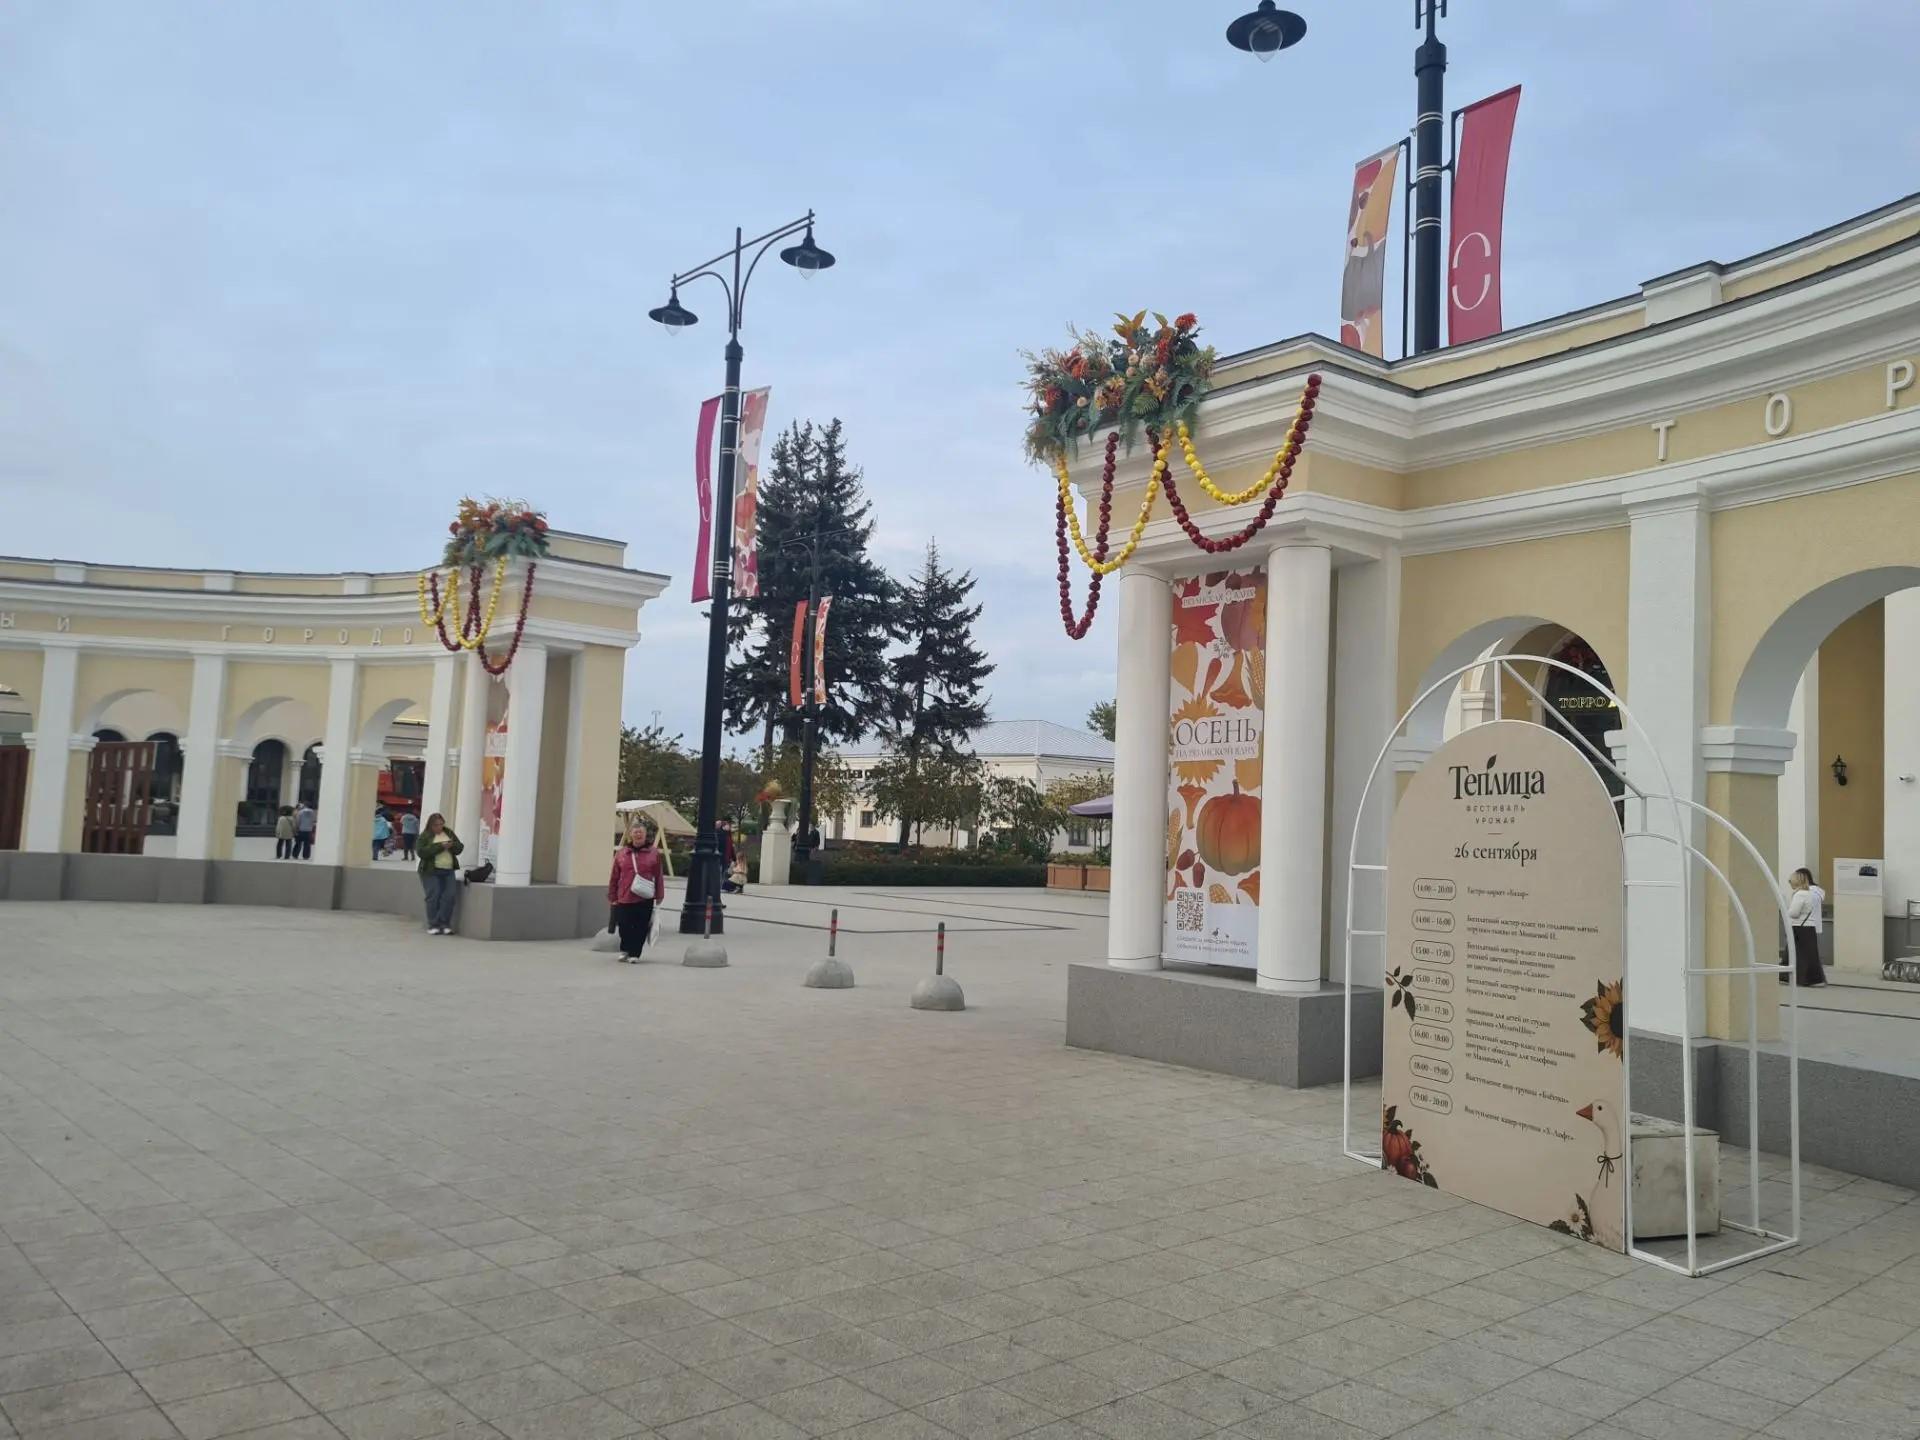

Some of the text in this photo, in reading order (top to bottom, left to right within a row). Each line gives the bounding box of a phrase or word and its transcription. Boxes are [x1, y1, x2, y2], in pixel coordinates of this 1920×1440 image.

[1176, 718, 1257, 745] ОСЕНЬ
[1449, 763, 1546, 800] Теплица
[1465, 804, 1526, 813] ФЕСТИВАЛЬ
[1475, 816, 1516, 824] УРОЖАЯ
[1453, 840, 1537, 868] 26 сентября
